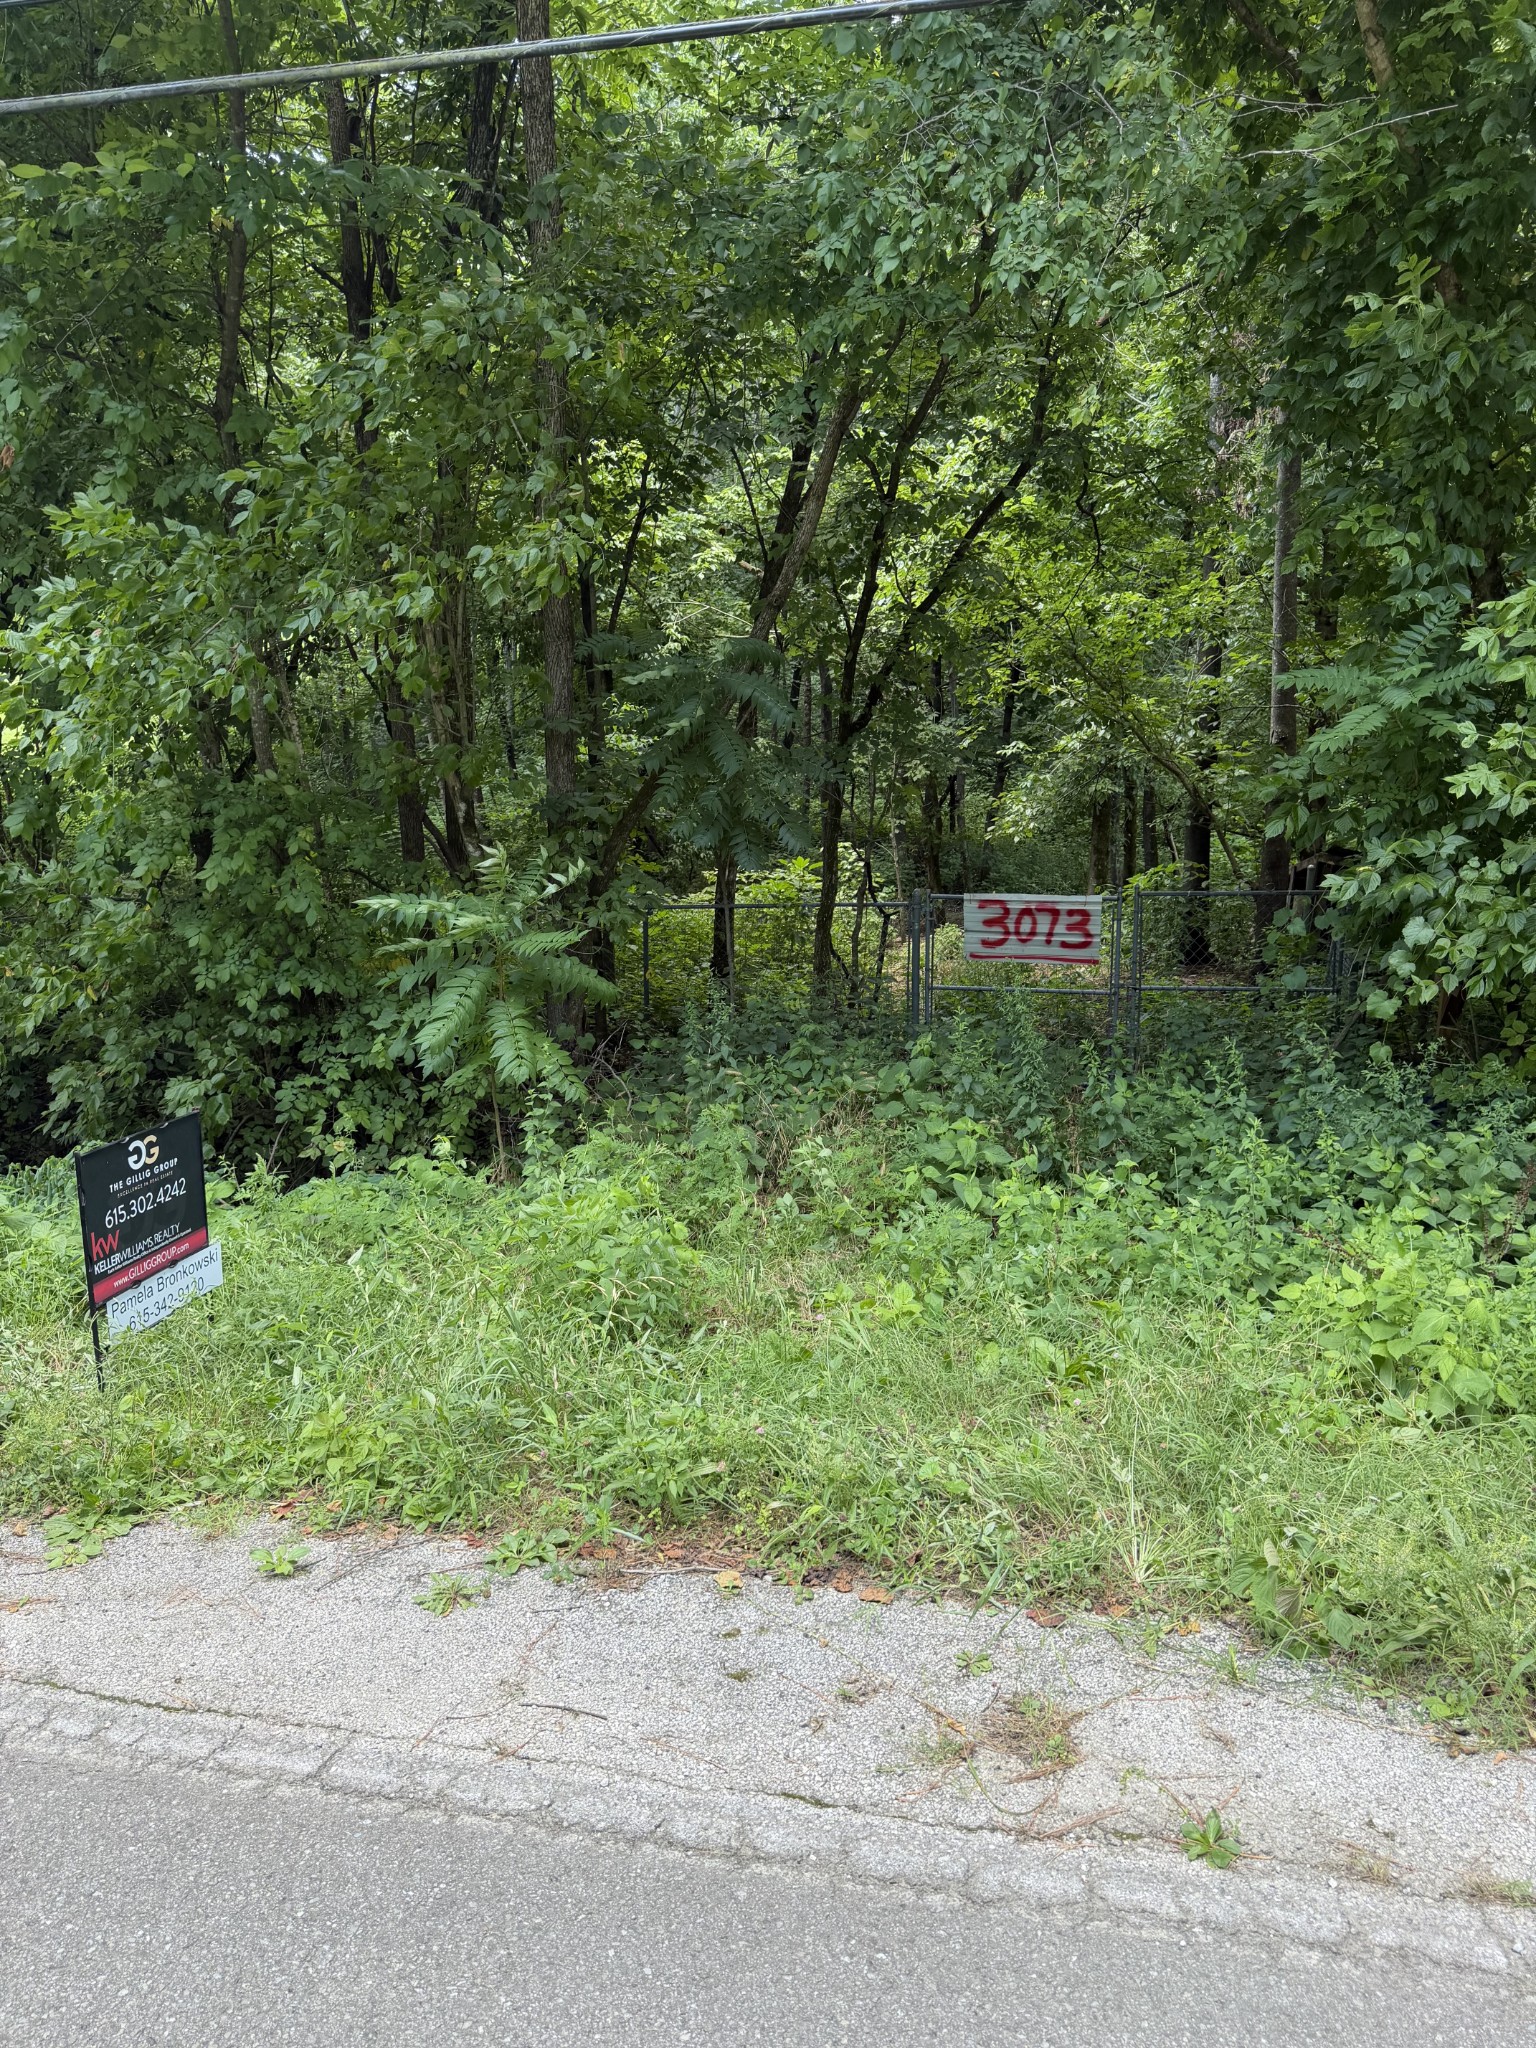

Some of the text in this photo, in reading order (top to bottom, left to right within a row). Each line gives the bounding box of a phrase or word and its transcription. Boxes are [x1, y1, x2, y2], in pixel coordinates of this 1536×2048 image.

[977, 899, 1094, 950] 3073
[109, 1157, 178, 1193] THE GILLIG GROUP
[105, 1177, 187, 1228] 615.302.4242
[90, 1229, 120, 1261] kw
[153, 1222, 180, 1245] REALTY
[112, 1285, 154, 1318] Pamela
[156, 1247, 218, 1293] Bronkowski
[113, 1242, 190, 1288] www.GILLIGGROUP.com
